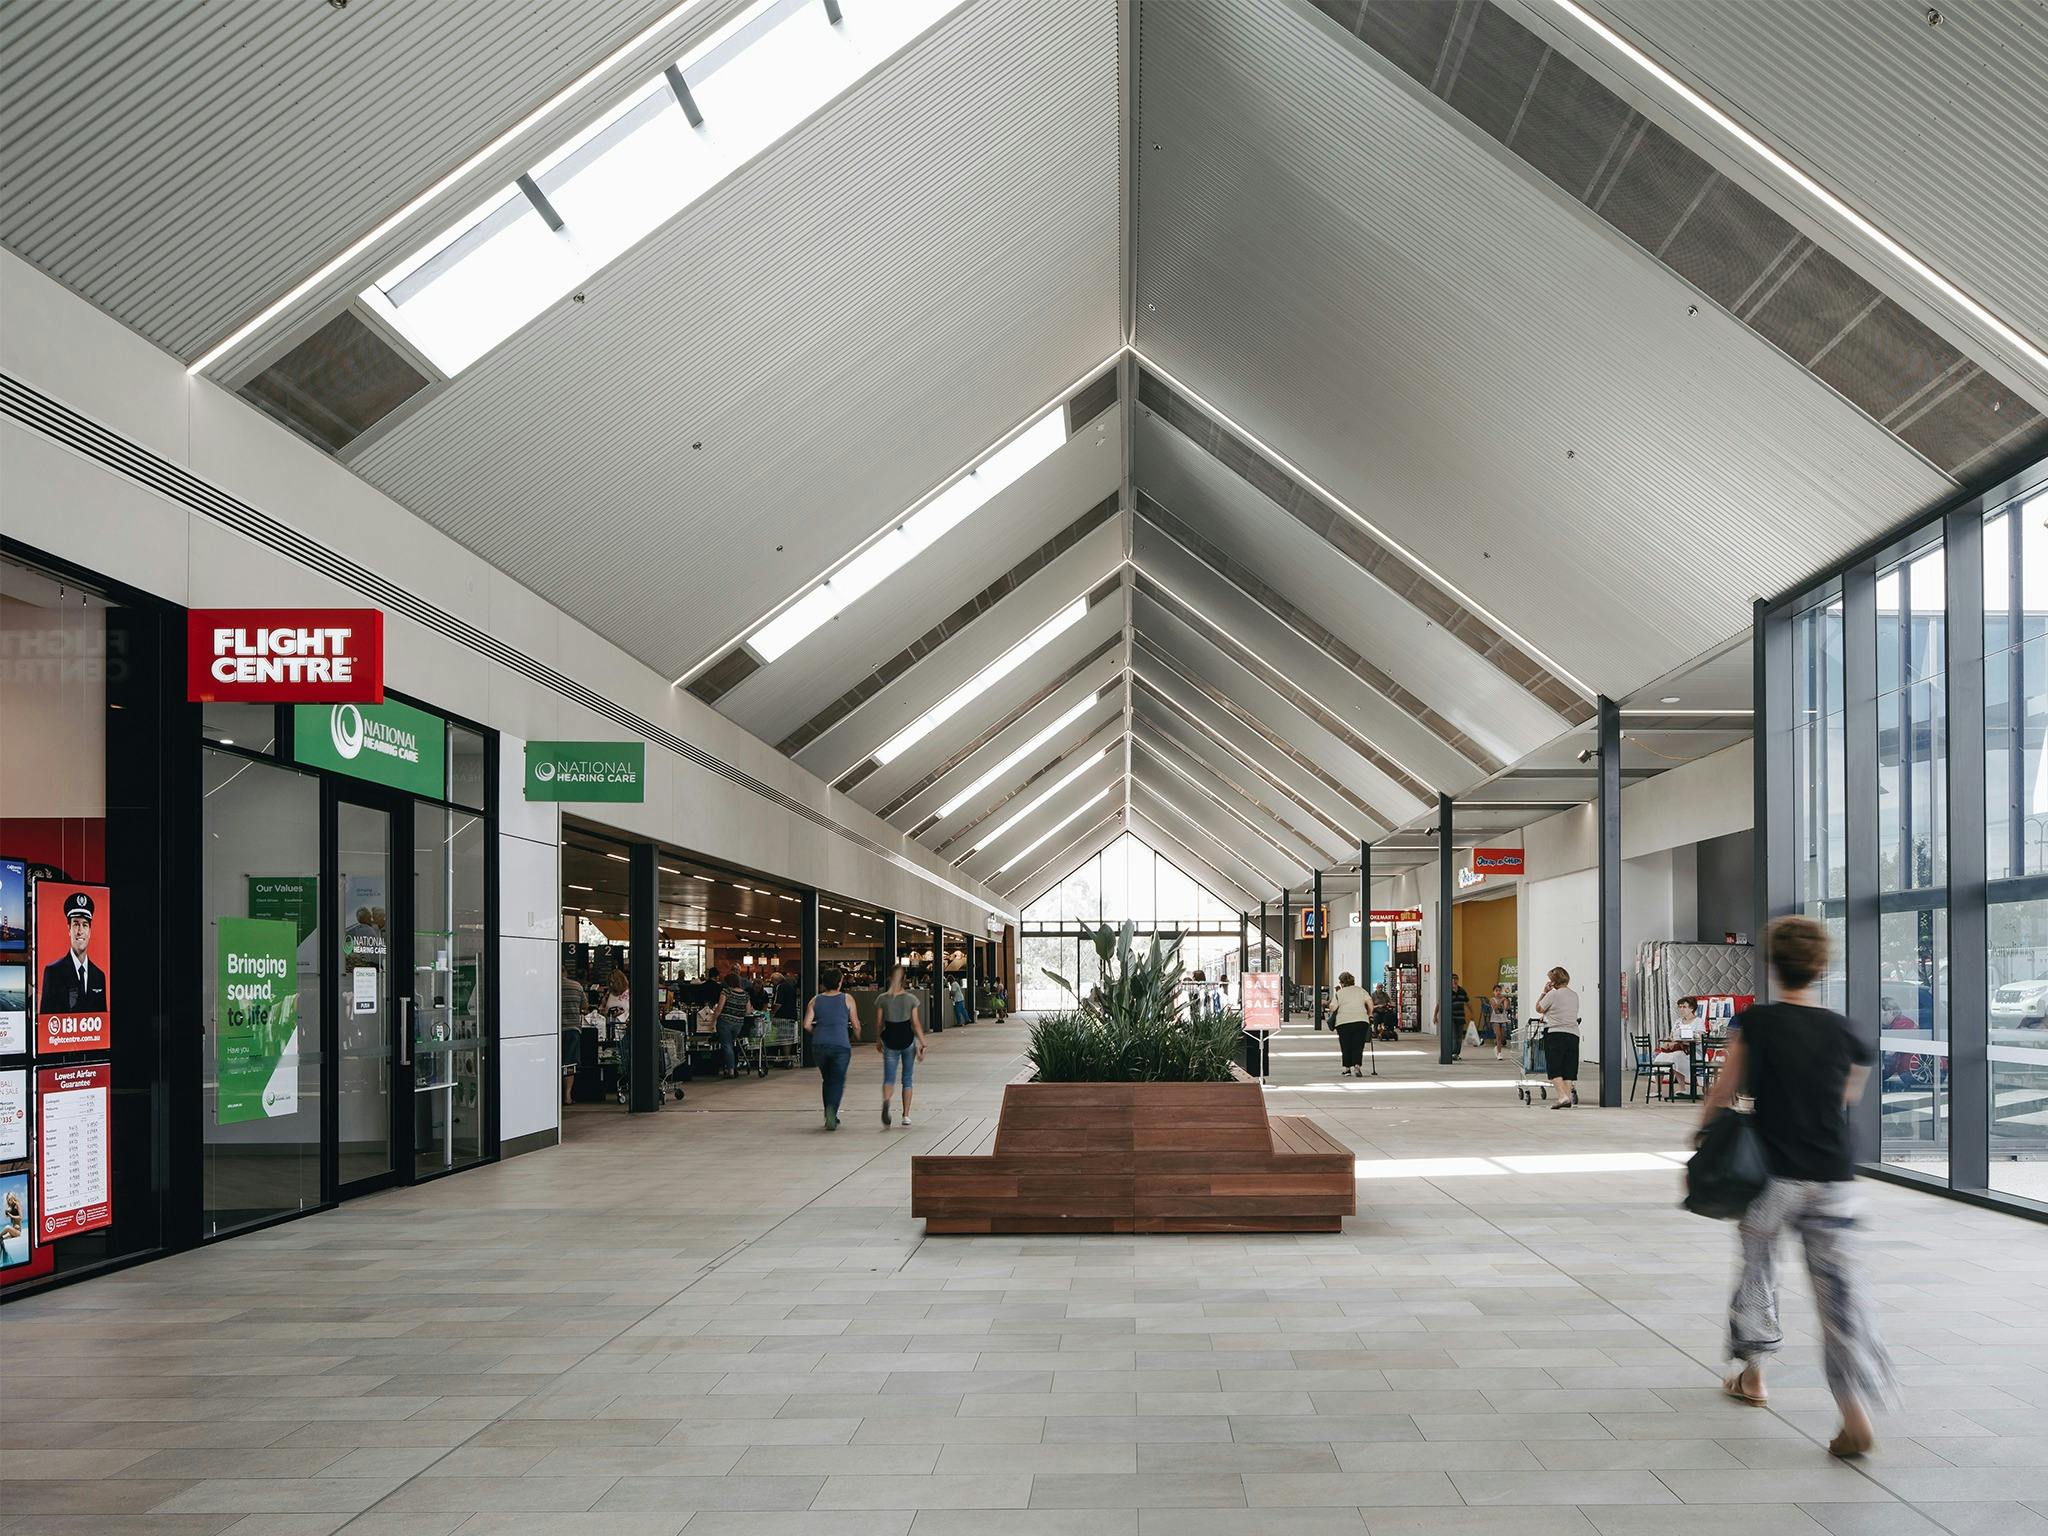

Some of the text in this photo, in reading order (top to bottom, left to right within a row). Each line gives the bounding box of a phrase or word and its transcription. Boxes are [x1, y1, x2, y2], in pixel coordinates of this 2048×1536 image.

[214, 628, 352, 656] FLIGHT
[211, 657, 352, 683] CENTRE
[364, 719, 419, 751] NATIONAL
[364, 736, 419, 763] HEARING CARE
[558, 761, 636, 774] NATIONAL
[557, 773, 636, 783] HEARING CARE
[256, 884, 303, 893] Our Values
[353, 936, 387, 948] NATIONAL
[353, 946, 387, 955] HEARING CARE
[568, 943, 576, 955] 3
[604, 945, 612, 957] 2
[227, 953, 287, 978] Bringing
[227, 979, 271, 1001] sound
[1246, 980, 1279, 989] SALE
[1246, 999, 1279, 1009] SALE
[227, 1004, 268, 1027] to life
[62, 1016, 102, 1033] 131 600
[49, 1035, 101, 1046] flightcentre.com.au
[227, 1046, 250, 1055] Have you
[54, 1069, 97, 1081] Lowest Airfare
[60, 1079, 91, 1089] Guarantee
